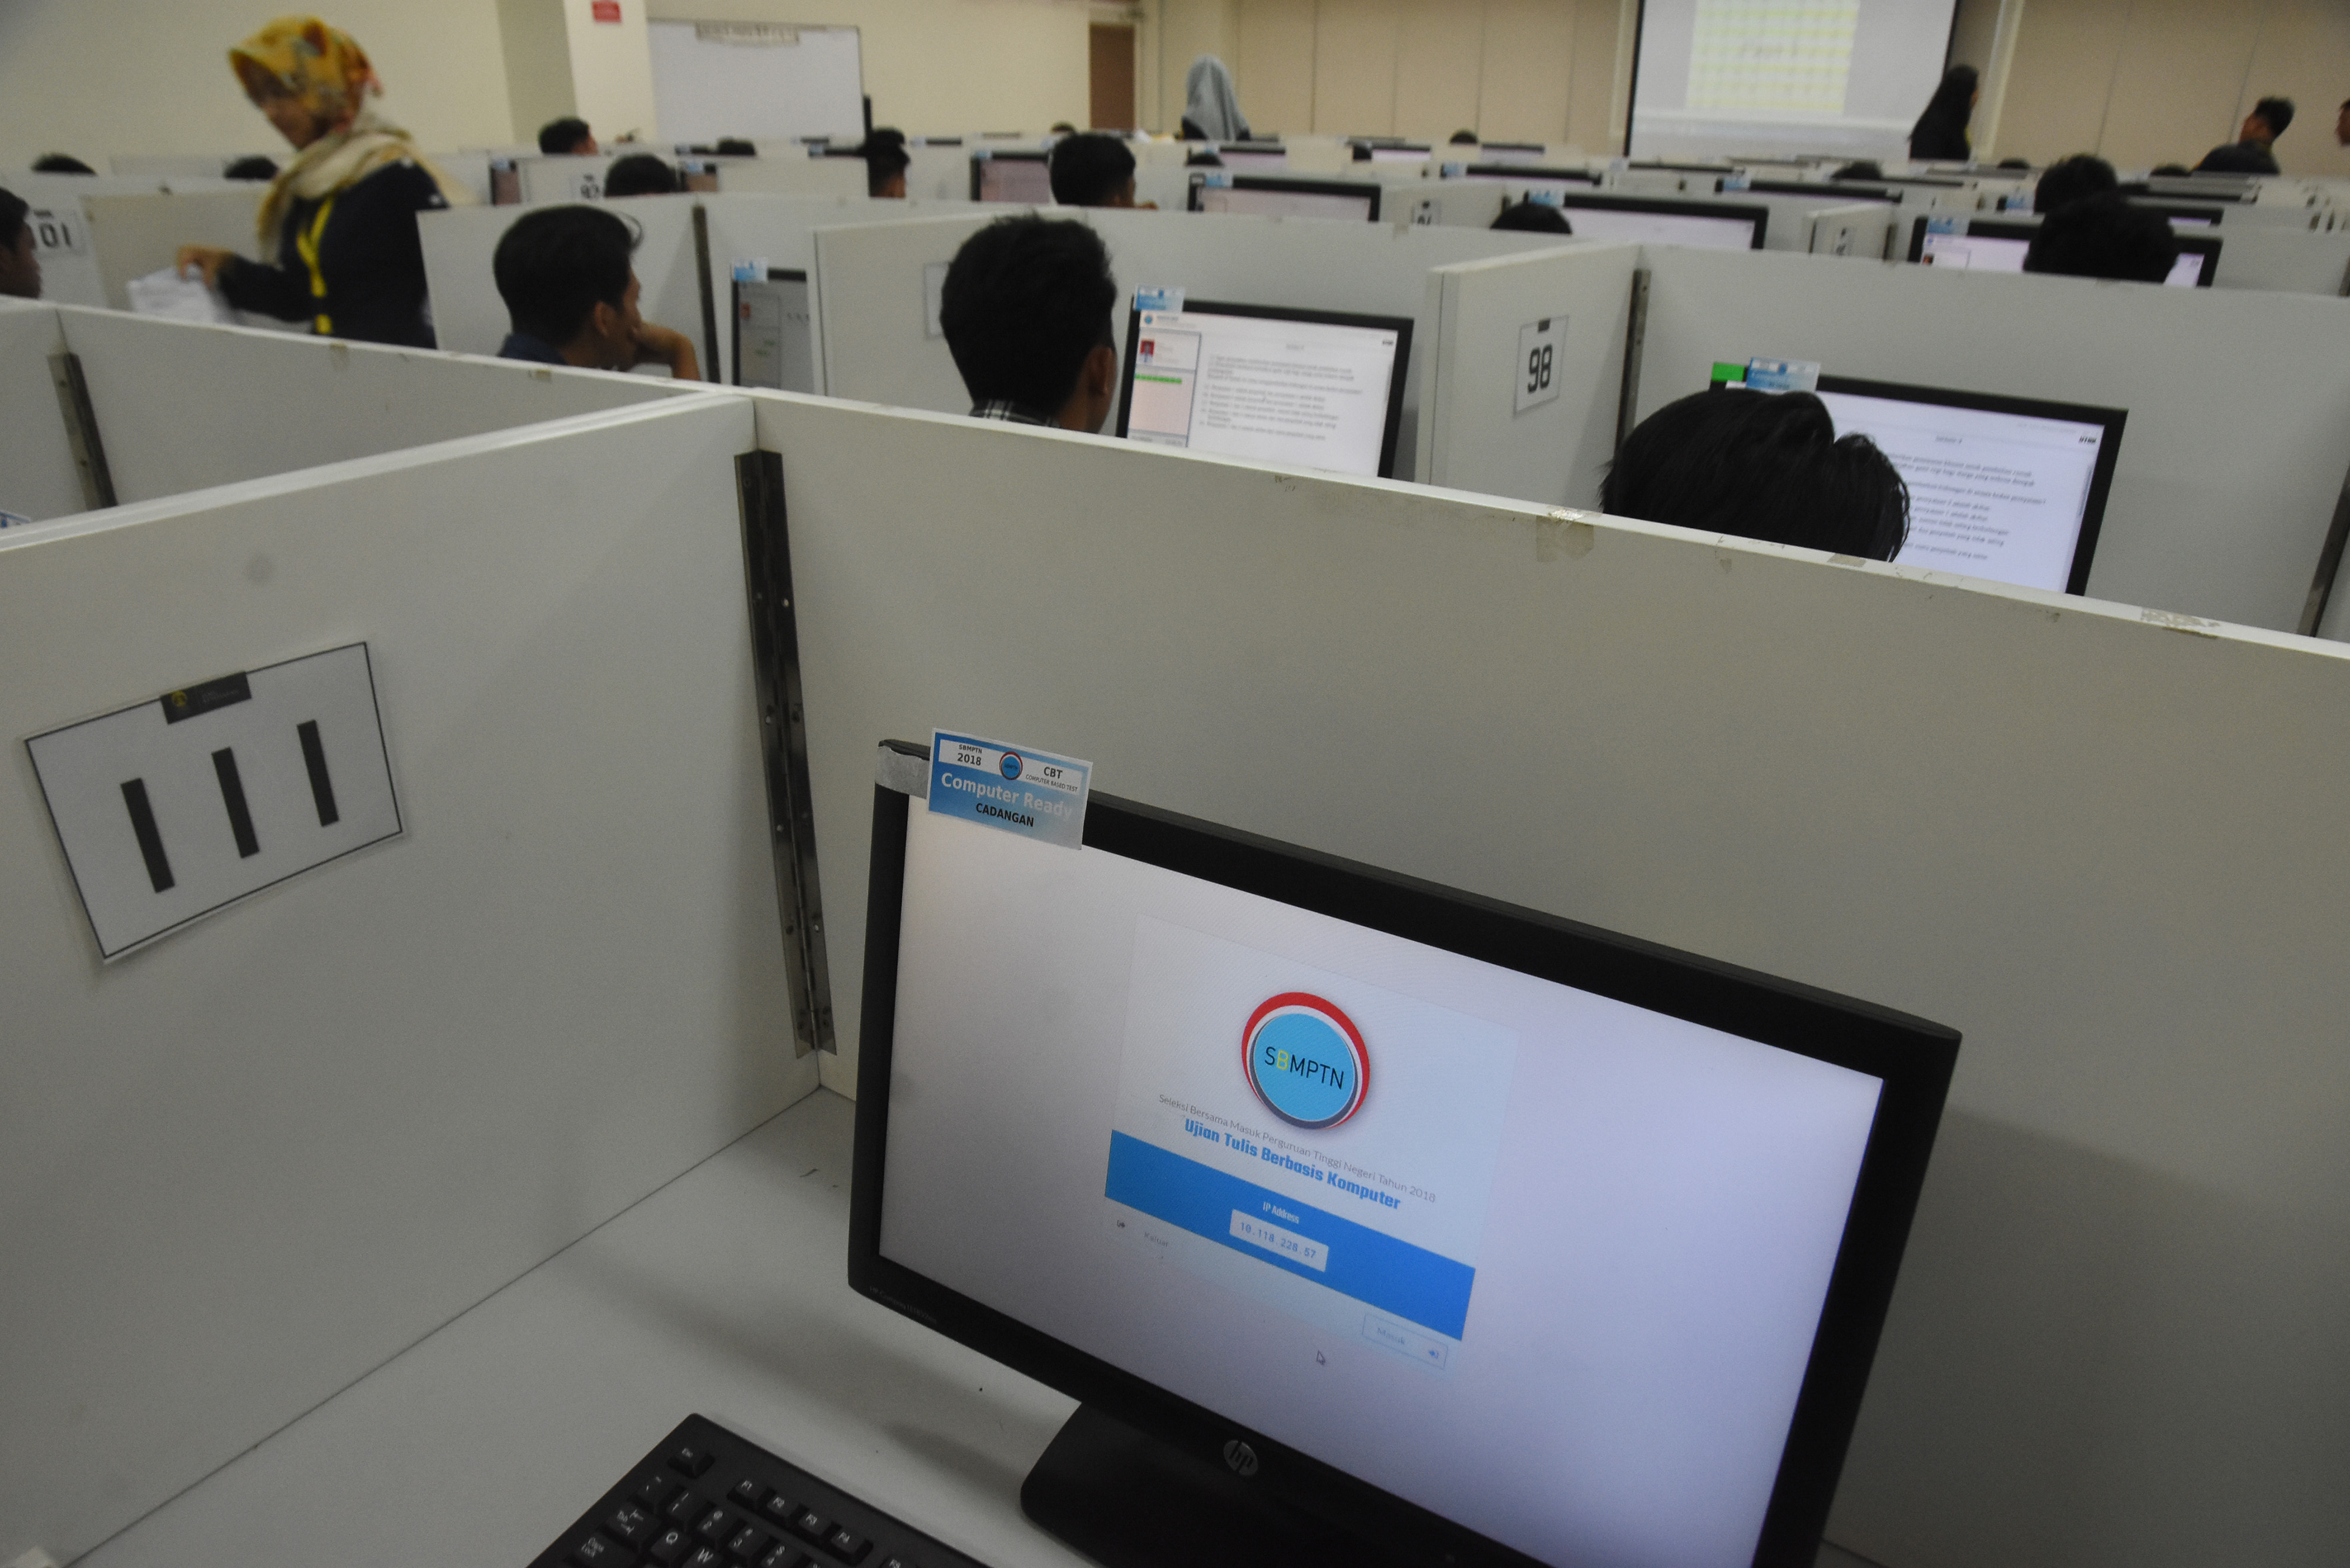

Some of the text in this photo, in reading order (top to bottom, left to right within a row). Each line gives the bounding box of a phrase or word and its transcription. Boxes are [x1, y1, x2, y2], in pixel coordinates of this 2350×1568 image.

[39, 222, 72, 247] 01
[1527, 343, 1553, 394] 98
[957, 753, 982, 766] 2018
[958, 744, 982, 754] SBMPTN
[1025, 774, 1078, 792] COMPUTER BASED TEST
[1043, 766, 1063, 779] CBT
[120, 718, 340, 894] 111
[941, 772, 1074, 820] Computer Ready
[976, 803, 1034, 827] CADANGAN
[1264, 1046, 1345, 1090] SBMPTN
[1159, 1093, 1436, 1203] Seleksi Bersama Masuk Perguruan Tinggi Negeri Tahun 2018
[1184, 1117, 1401, 1210] Ujian Tulis Berbasis Komputer
[1263, 1201, 1300, 1224] IP Address
[741, 1480, 753, 1491] F1
[666, 1532, 679, 1545] Q
[697, 1549, 714, 1564] W
